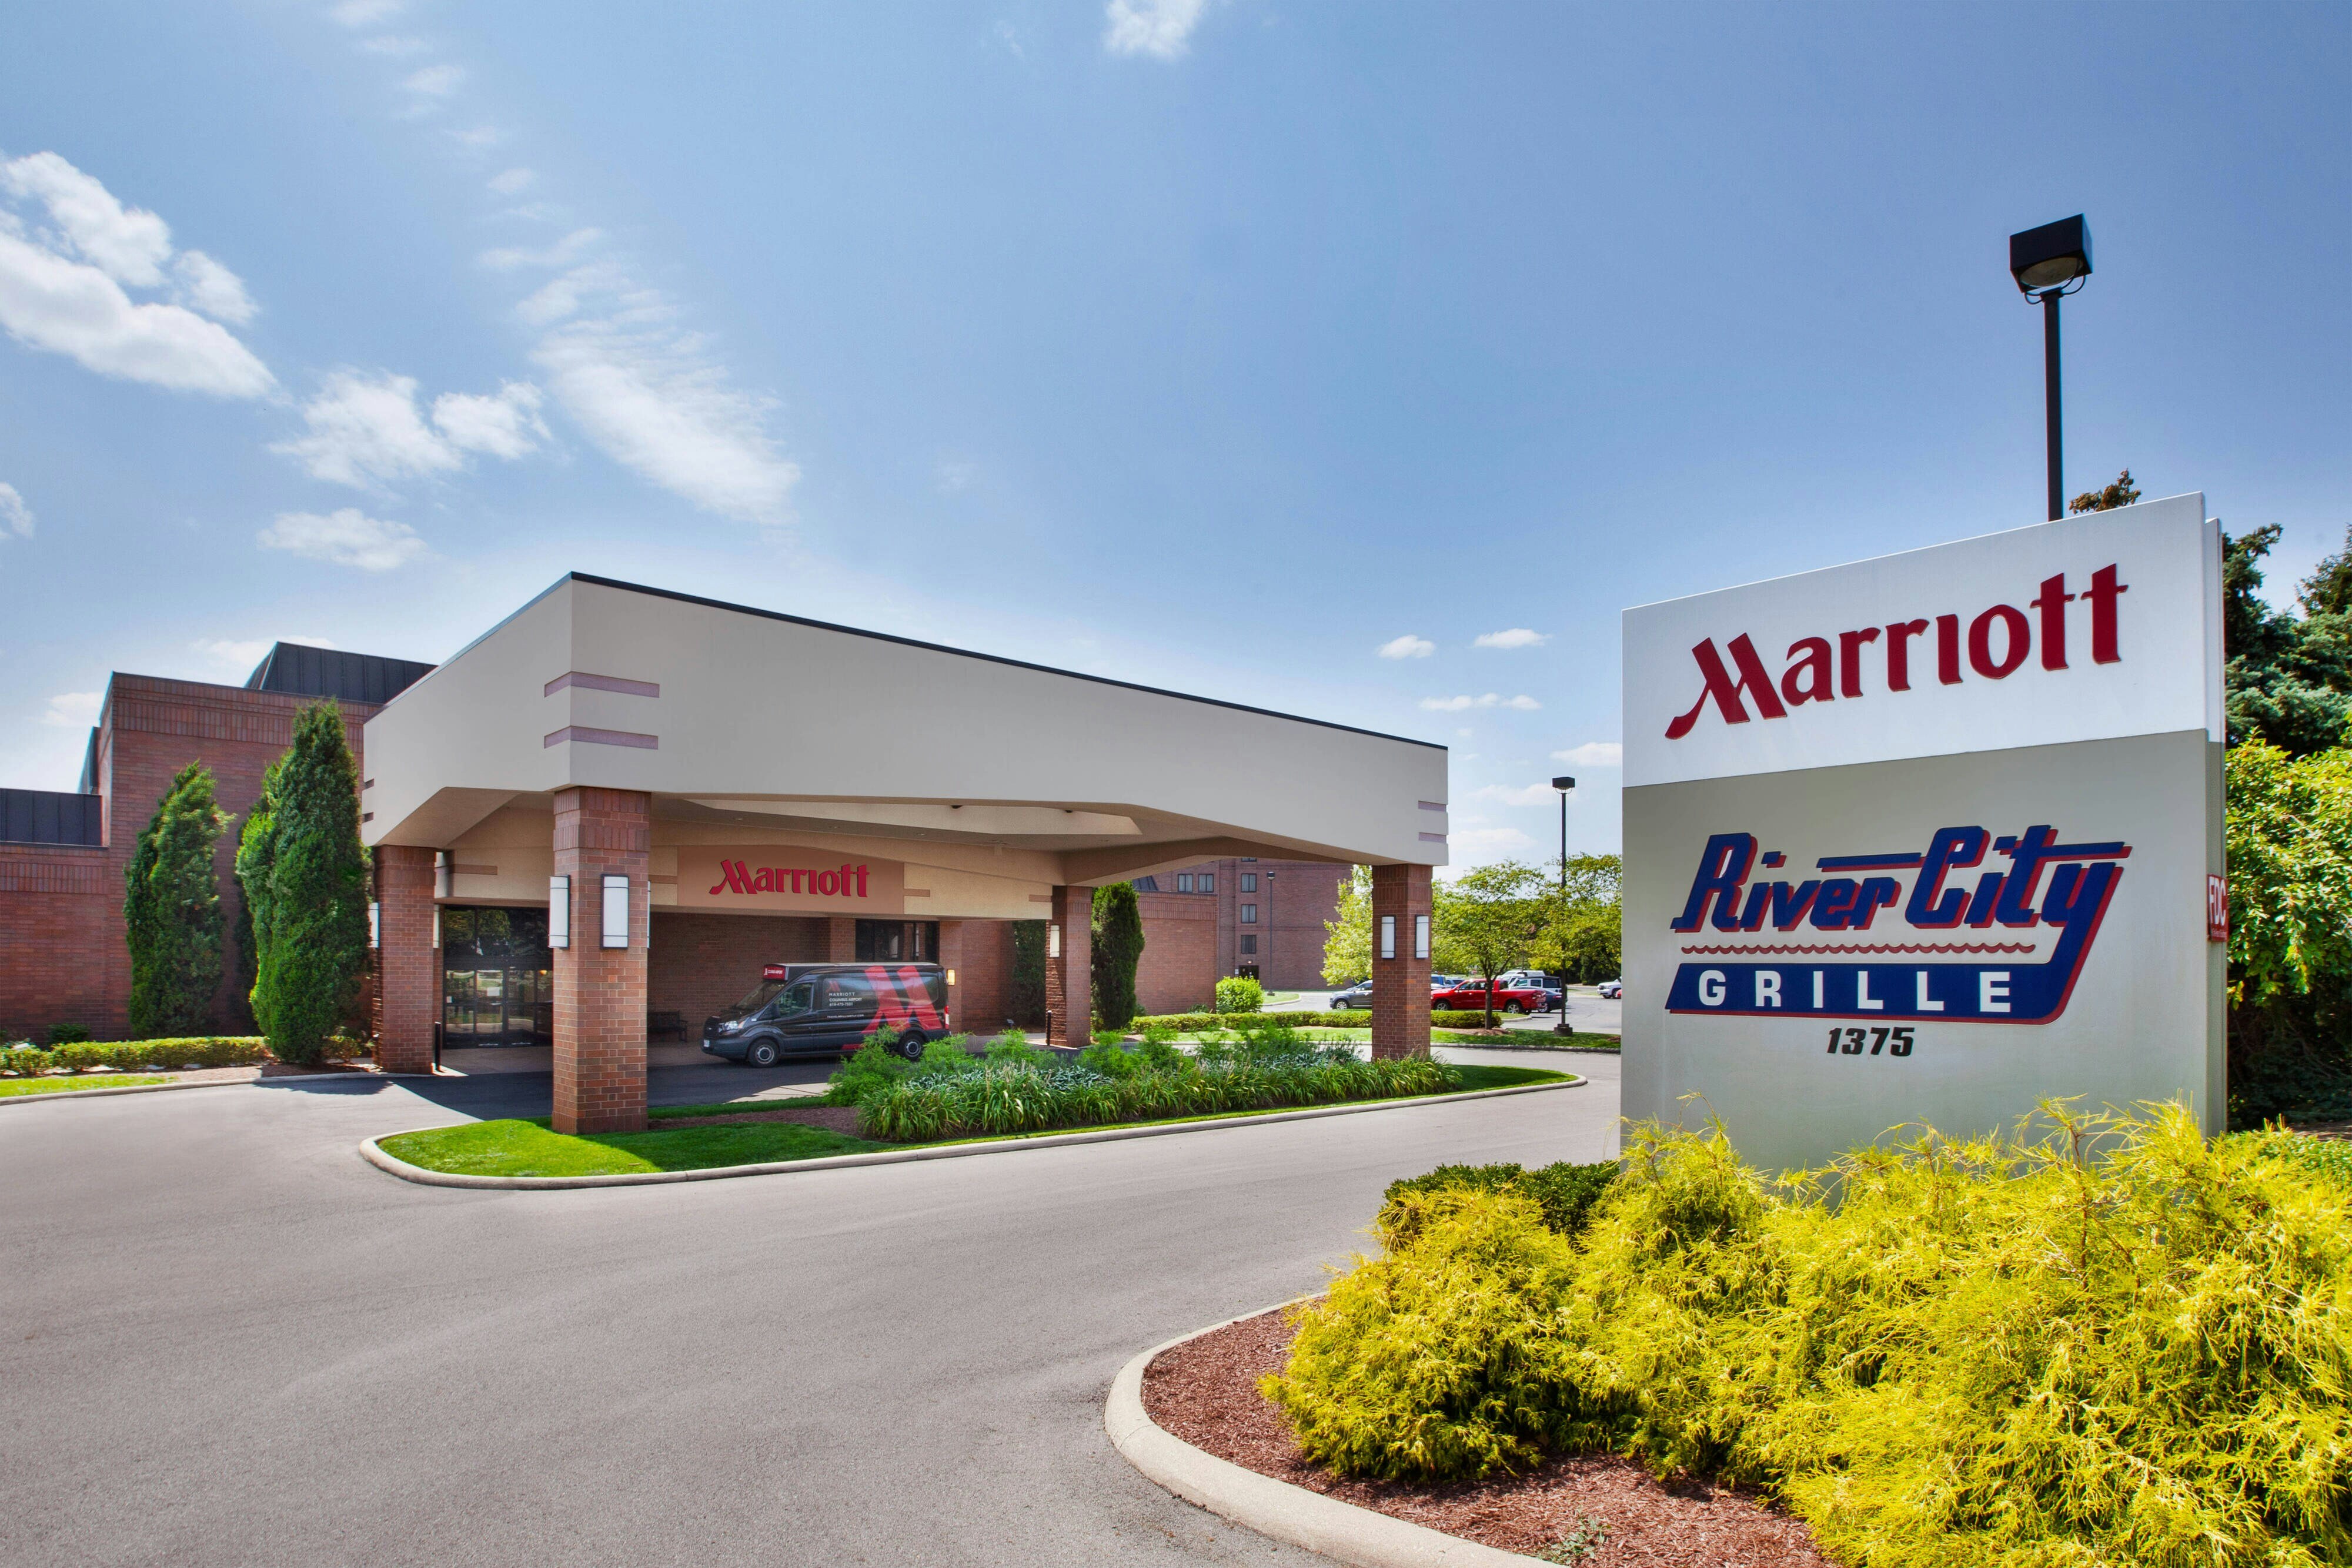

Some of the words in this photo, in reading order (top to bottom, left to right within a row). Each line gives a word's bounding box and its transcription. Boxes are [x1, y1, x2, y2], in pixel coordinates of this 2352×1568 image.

[1665, 563, 2129, 740] Marriott
[709, 859, 870, 898] Marriott
[1670, 832, 1902, 933] River
[1904, 825, 2132, 964] City
[2209, 875, 2226, 927] FDC
[1698, 969, 2012, 1012] GRILLE
[1826, 1026, 1915, 1057] 1375
